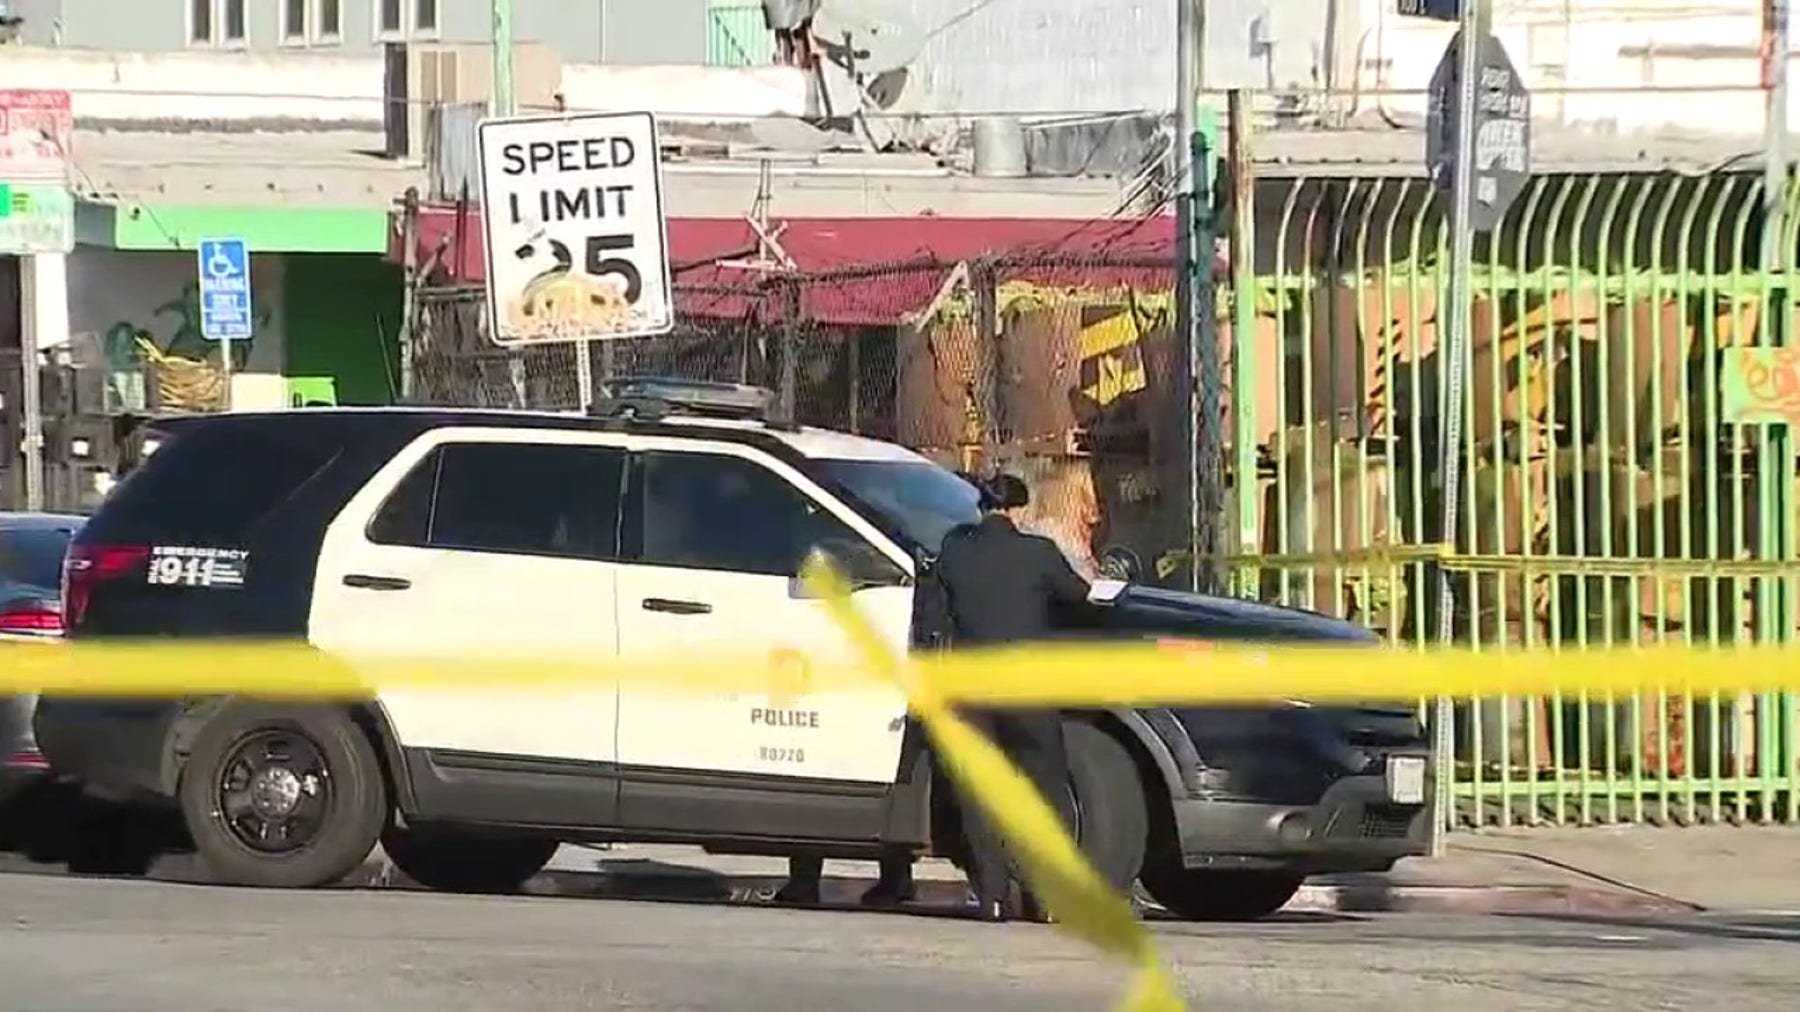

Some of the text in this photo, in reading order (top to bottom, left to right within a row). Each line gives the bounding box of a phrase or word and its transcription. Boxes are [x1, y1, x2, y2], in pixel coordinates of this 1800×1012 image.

[503, 137, 635, 176] SPEED
[161, 557, 214, 586] 911
[751, 708, 819, 728] POLICE
